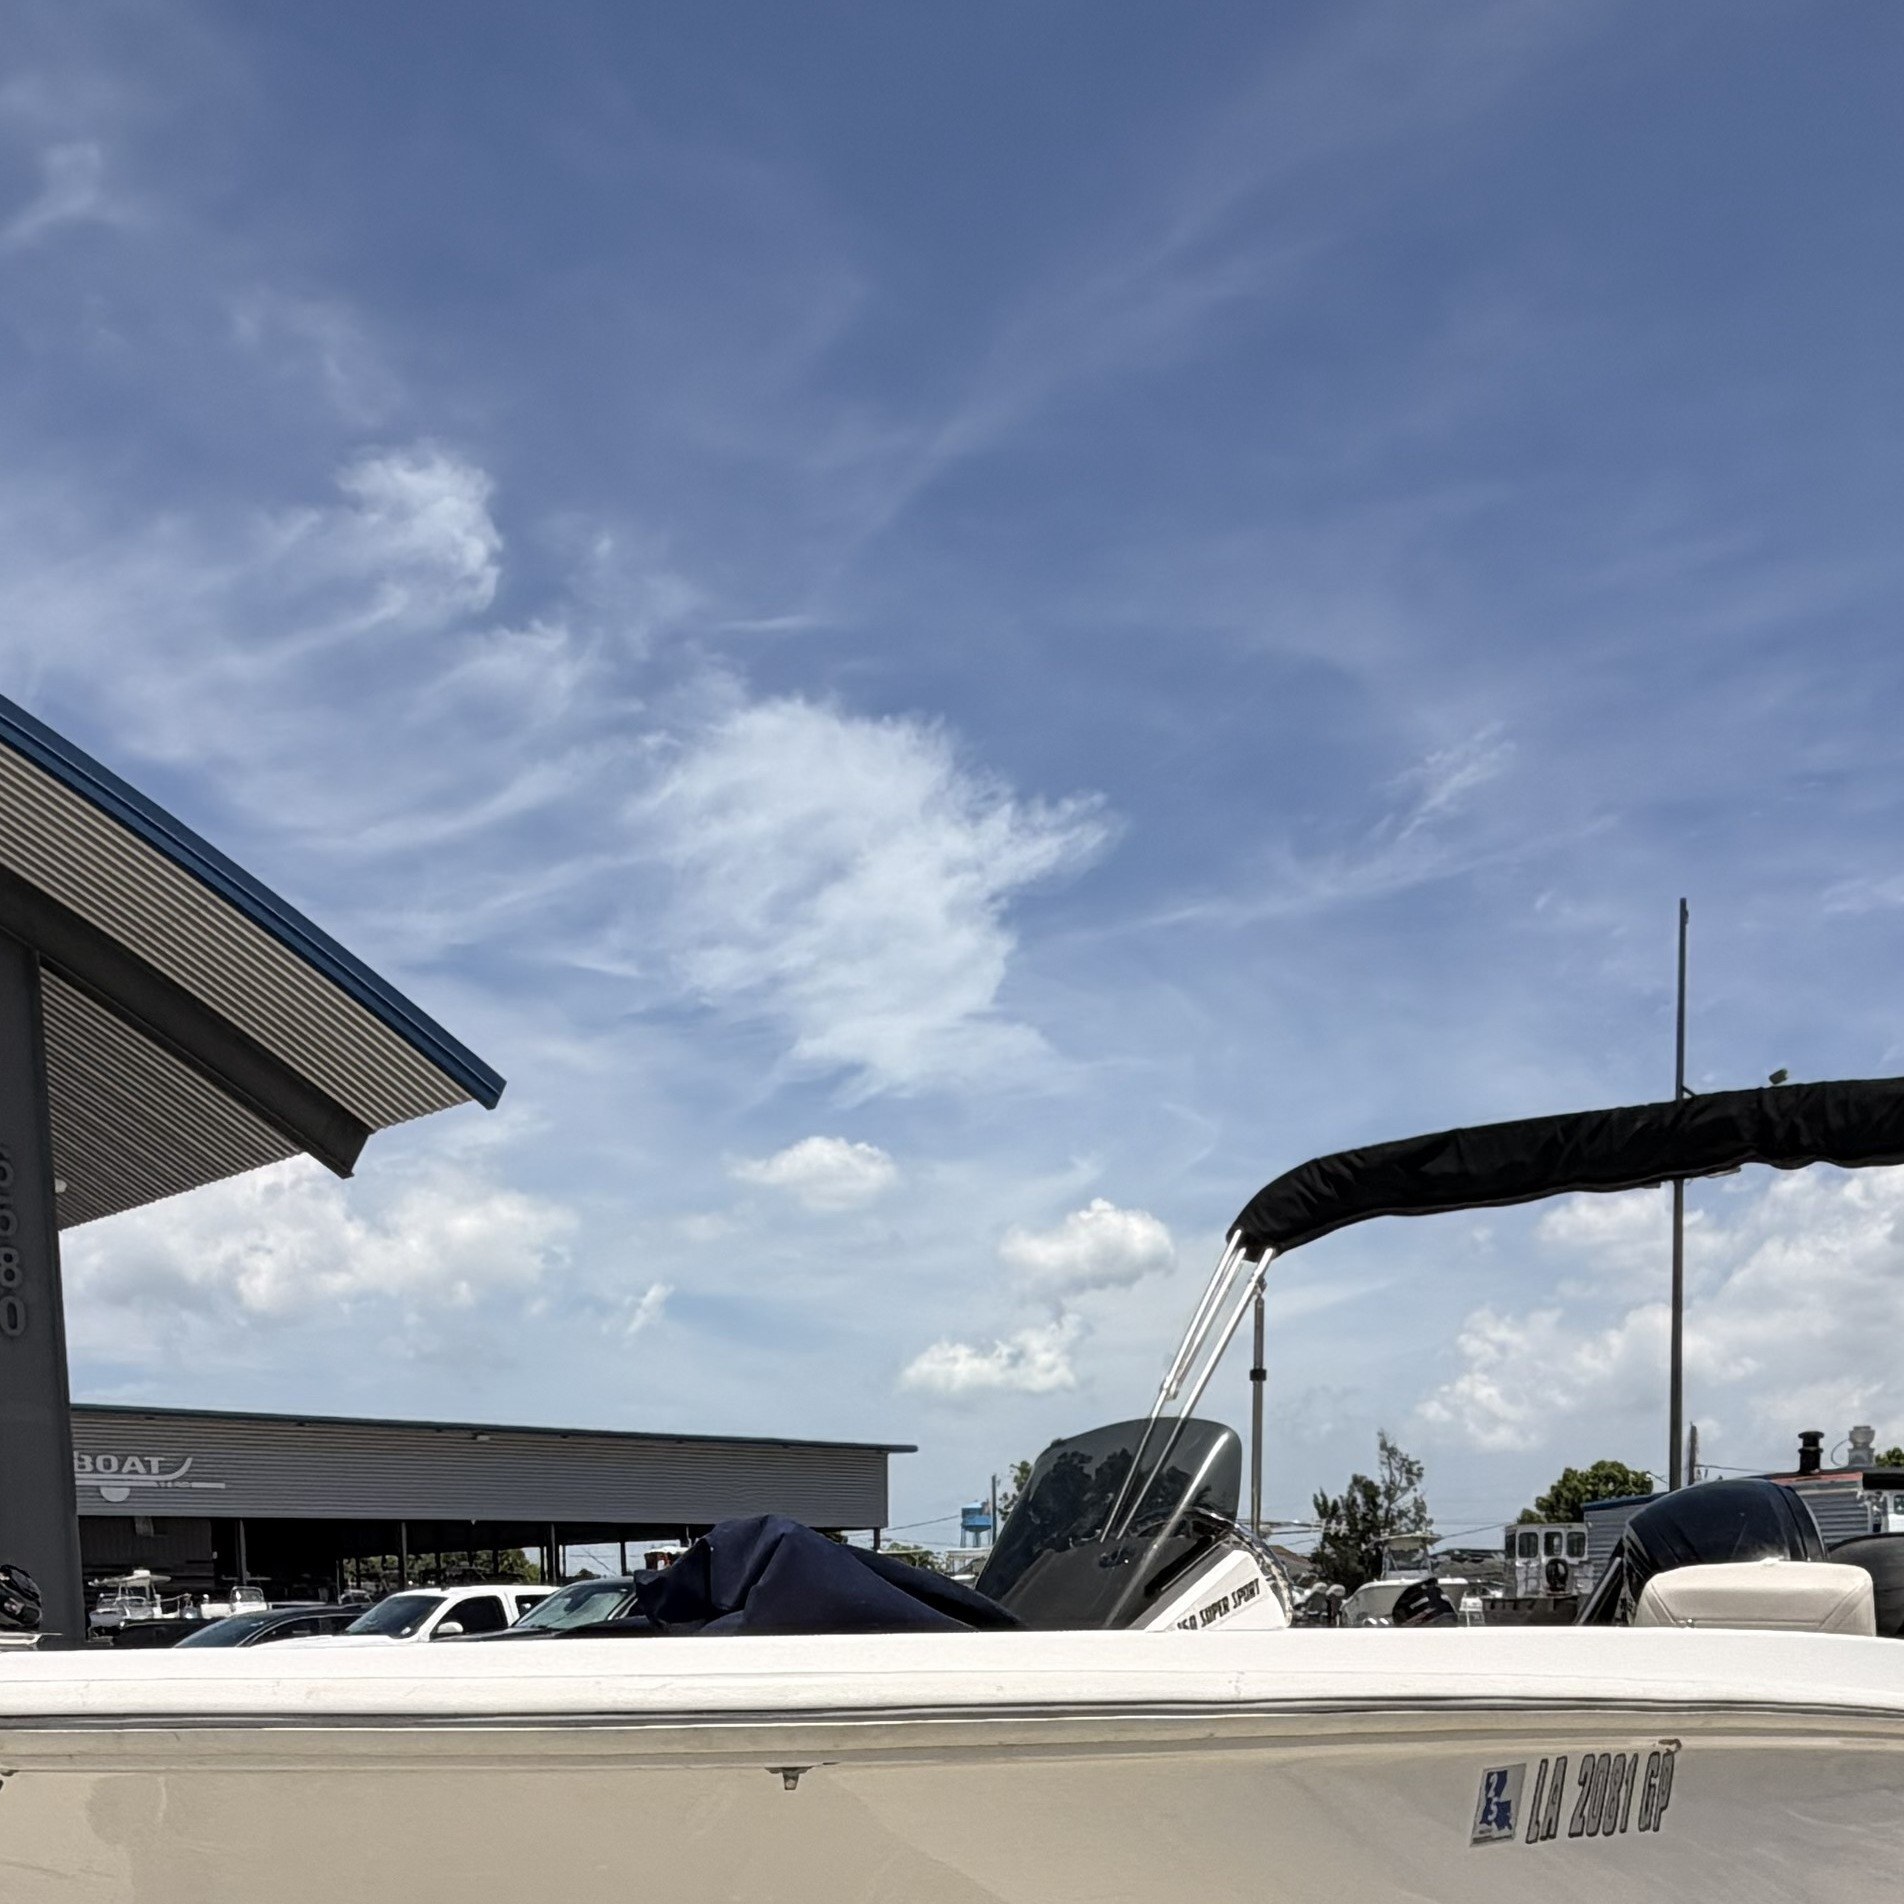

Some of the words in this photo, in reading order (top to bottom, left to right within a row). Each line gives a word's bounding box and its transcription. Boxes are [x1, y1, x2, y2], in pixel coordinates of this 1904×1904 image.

[74, 1453, 165, 1474] BOAT
[1199, 1595, 1230, 1628] SUPER
[1231, 1578, 1260, 1609] SPORT
[1525, 1755, 1568, 1844] LA
[1567, 1752, 1639, 1838] 2081
[1638, 1751, 1675, 1832] GP
